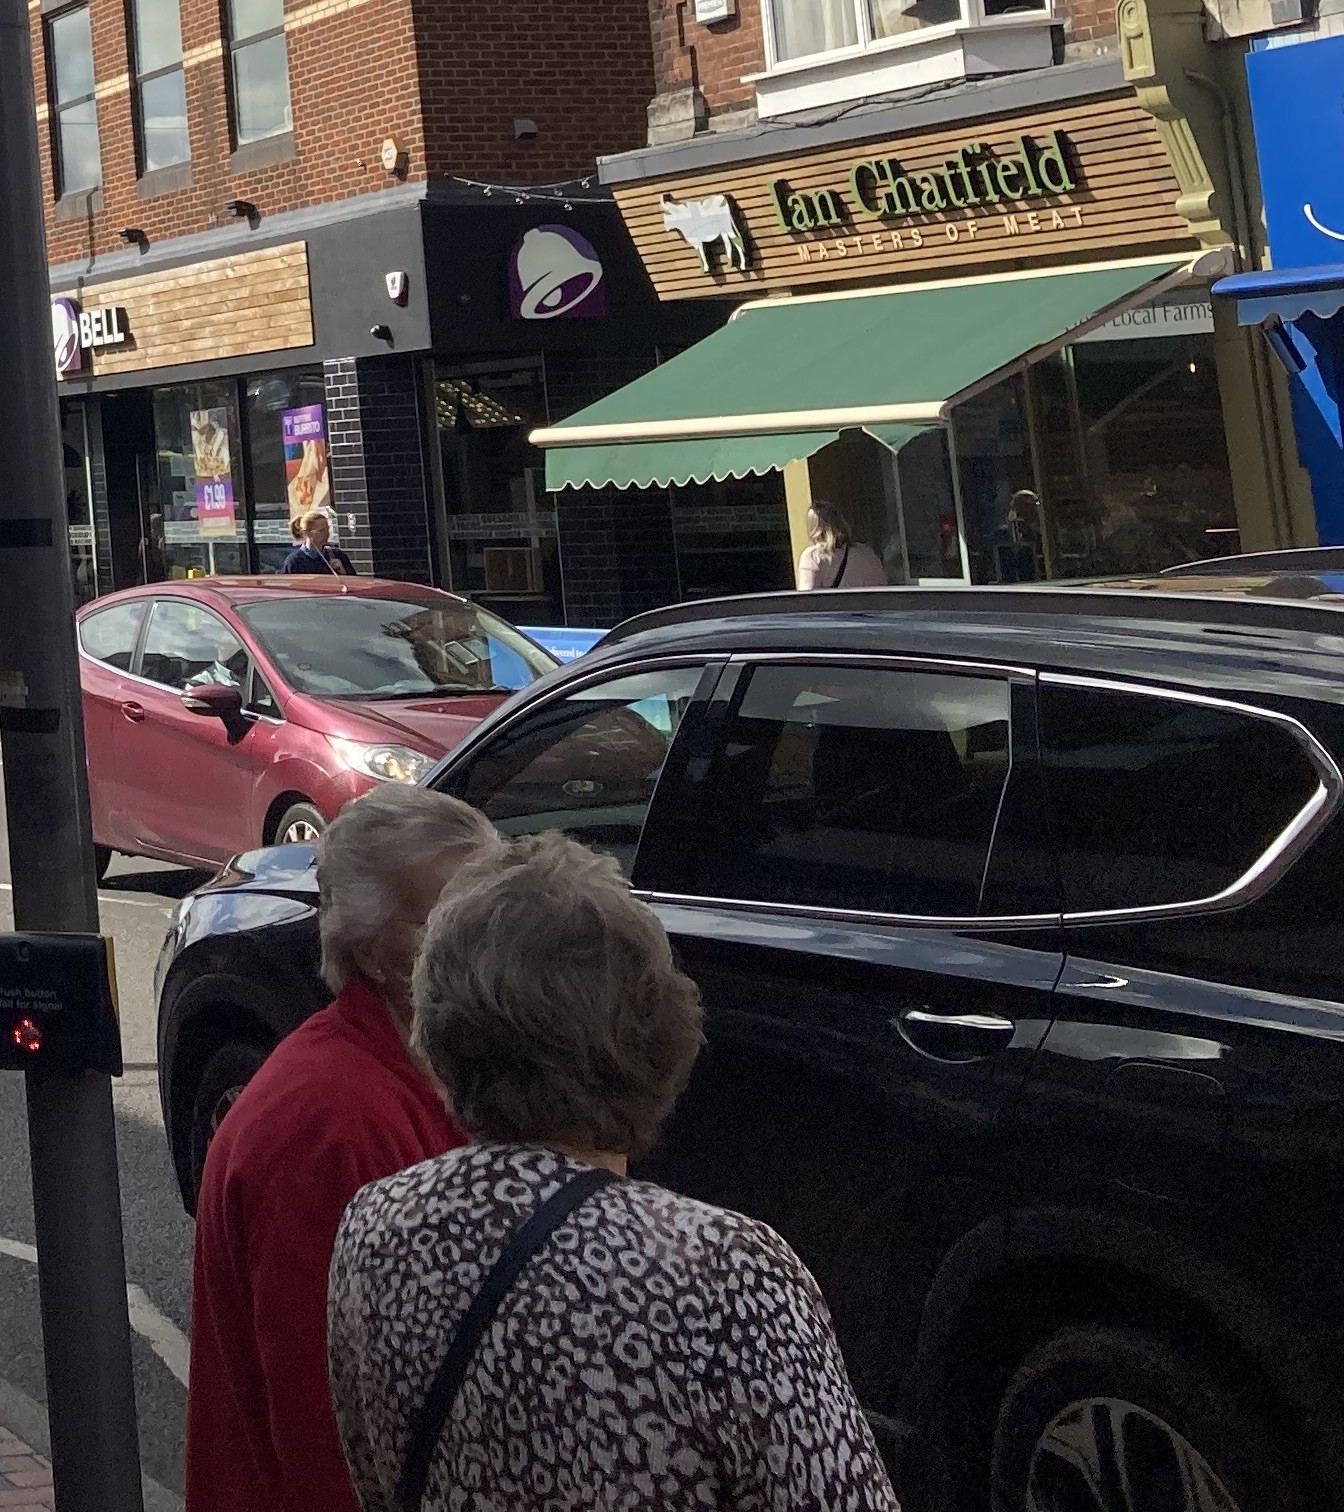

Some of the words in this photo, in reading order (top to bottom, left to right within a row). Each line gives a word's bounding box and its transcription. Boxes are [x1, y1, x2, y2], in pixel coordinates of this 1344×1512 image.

[766, 179, 842, 234] Ian
[848, 131, 1075, 219] Chatfield
[797, 228, 924, 263] MASTERS
[945, 220, 979, 243] OF
[1002, 205, 1087, 236] MEAT
[79, 307, 125, 348] BELL
